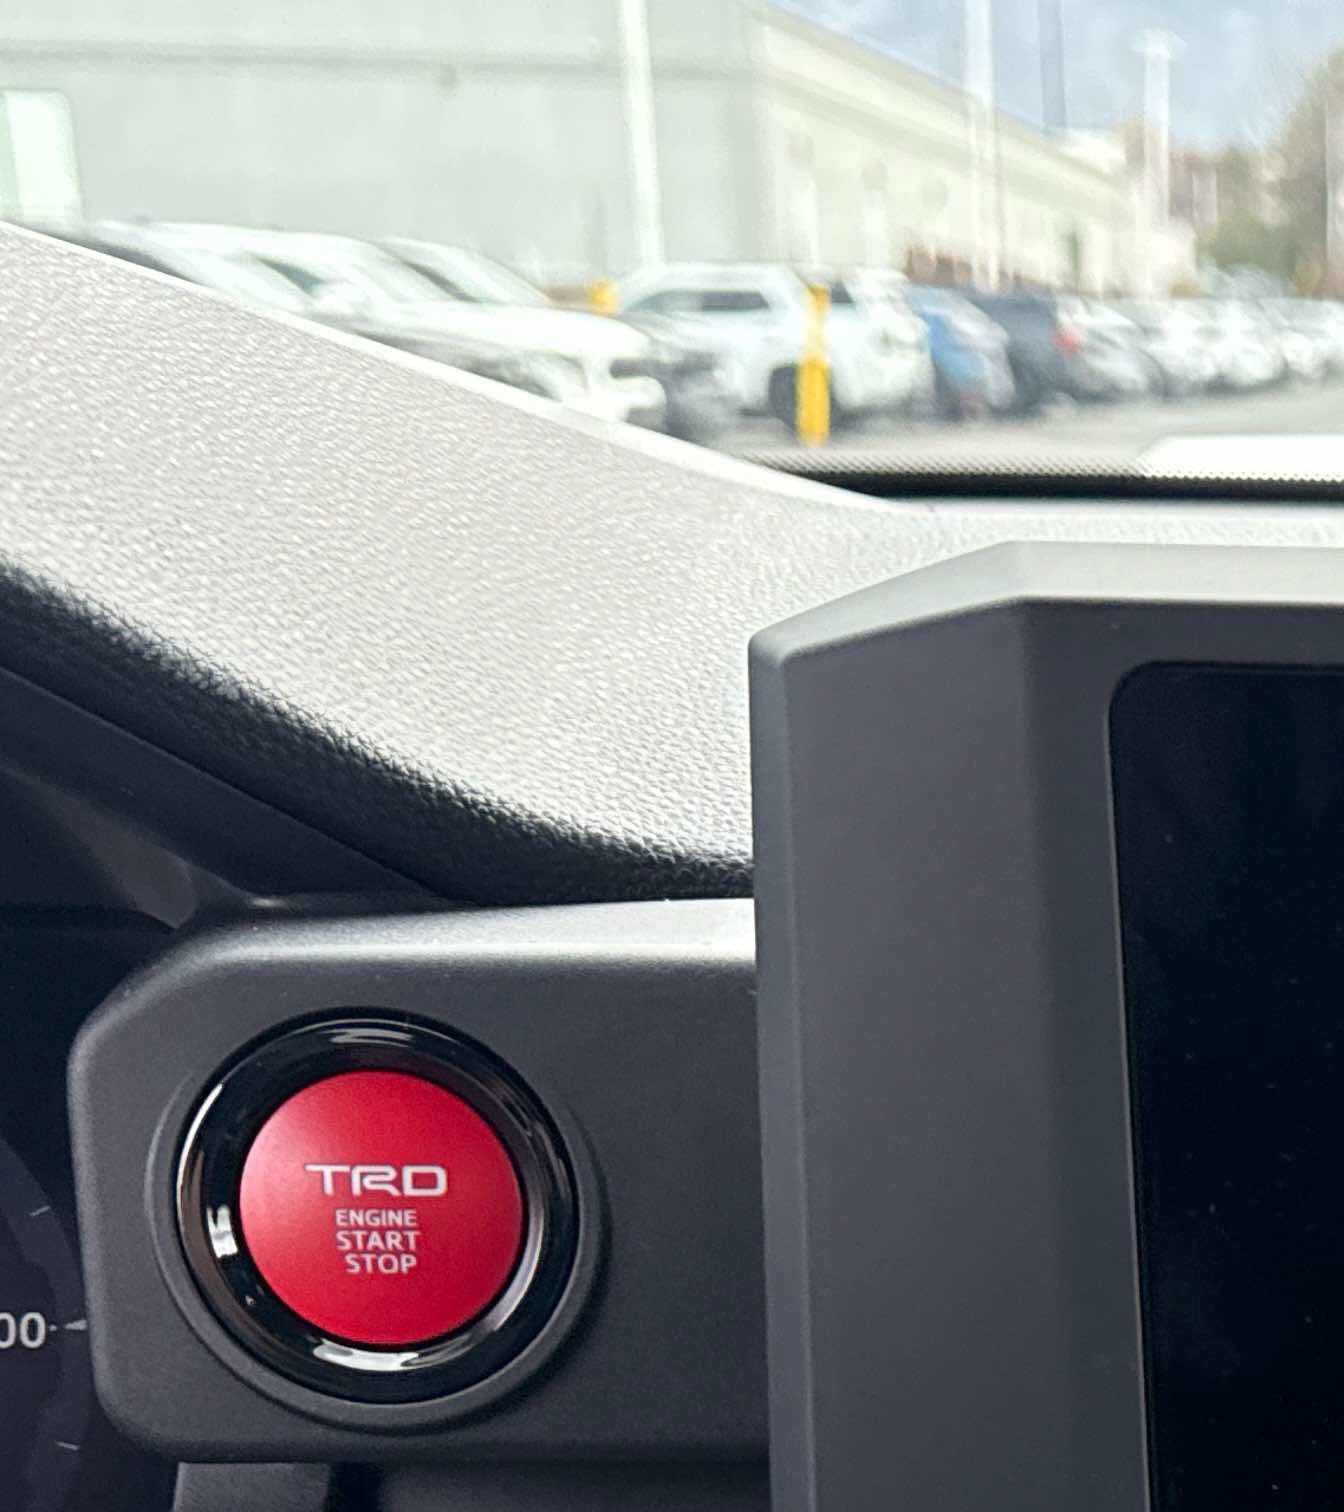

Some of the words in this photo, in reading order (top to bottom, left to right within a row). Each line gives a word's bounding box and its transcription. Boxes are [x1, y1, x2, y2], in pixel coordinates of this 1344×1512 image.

[305, 1164, 447, 1196] TRD
[335, 1208, 417, 1227] ENGINE
[336, 1230, 421, 1251] START
[344, 1253, 417, 1274] STOP
